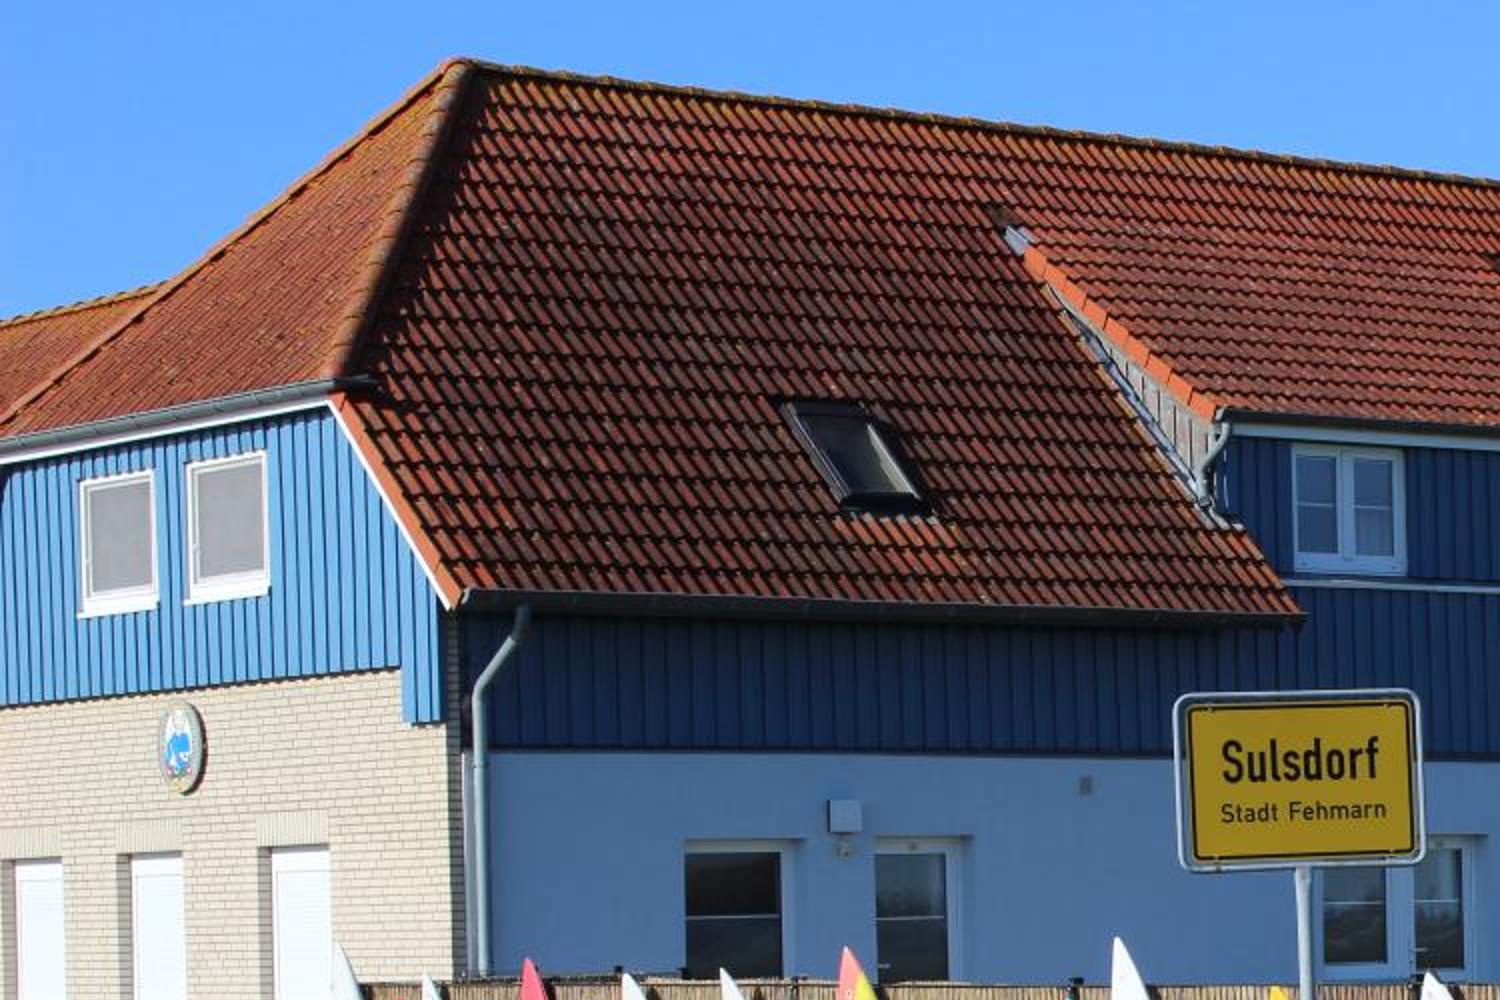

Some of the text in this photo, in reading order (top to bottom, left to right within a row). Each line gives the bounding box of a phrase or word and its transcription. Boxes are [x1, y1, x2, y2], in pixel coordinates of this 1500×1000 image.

[1222, 736, 1379, 784] Sulsdorf
[1220, 800, 1387, 824] Stadt Fehmarn
